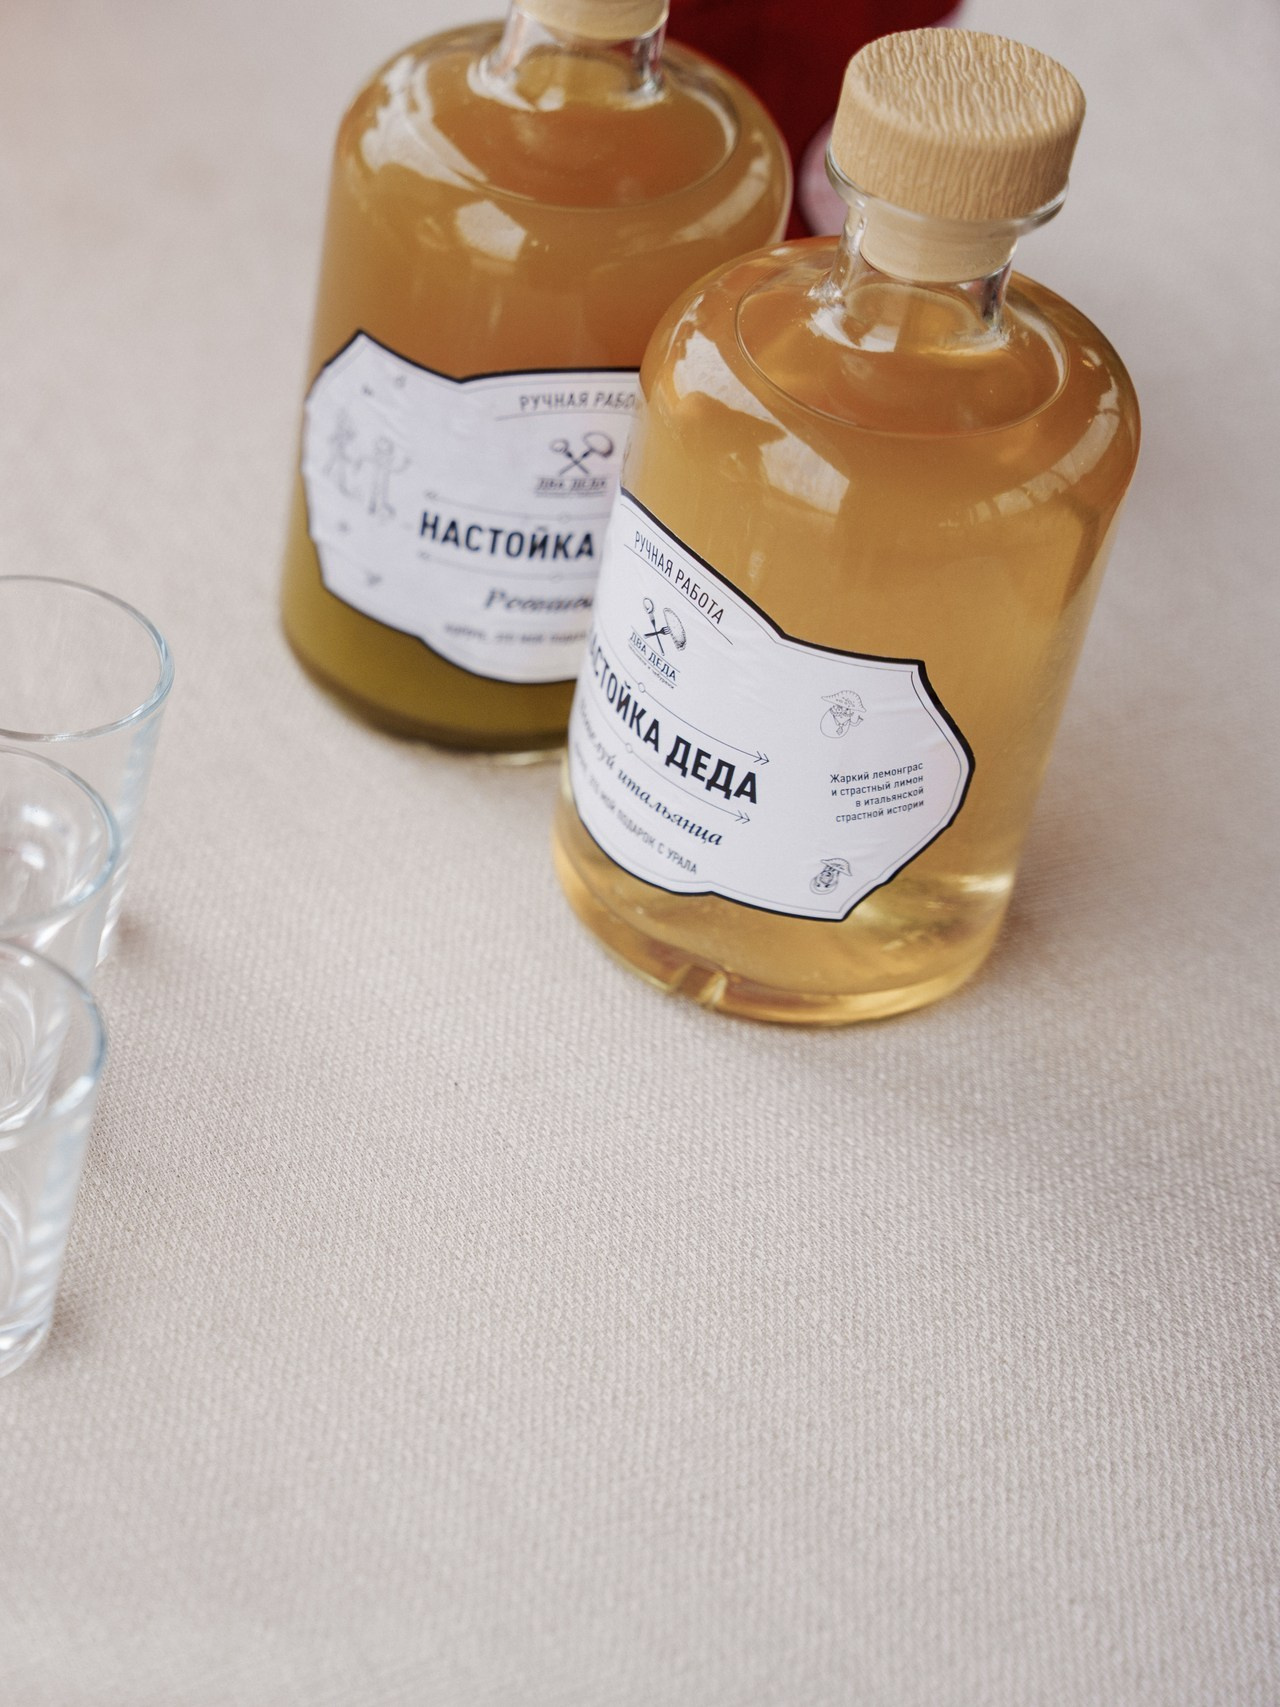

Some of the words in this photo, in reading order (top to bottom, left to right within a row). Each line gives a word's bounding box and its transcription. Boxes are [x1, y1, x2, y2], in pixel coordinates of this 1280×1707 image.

[420, 511, 594, 559] НАСТОЙКА
[634, 531, 673, 578] РУЧНАЯ
[675, 569, 724, 625] РАБОТА
[630, 632, 646, 655] ДВА
[648, 652, 676, 681] ДЕДА
[665, 735, 757, 804] ДЕДА
[830, 772, 869, 784] Жаркий
[872, 762, 923, 780] лемонграс
[840, 781, 891, 797] страстный
[894, 775, 923, 788] лимон
[618, 769, 723, 846] итальянца
[836, 808, 884, 823] страстной
[887, 800, 924, 815] истории
[864, 787, 924, 806] итальянской
[666, 848, 697, 875] УРАЛА
